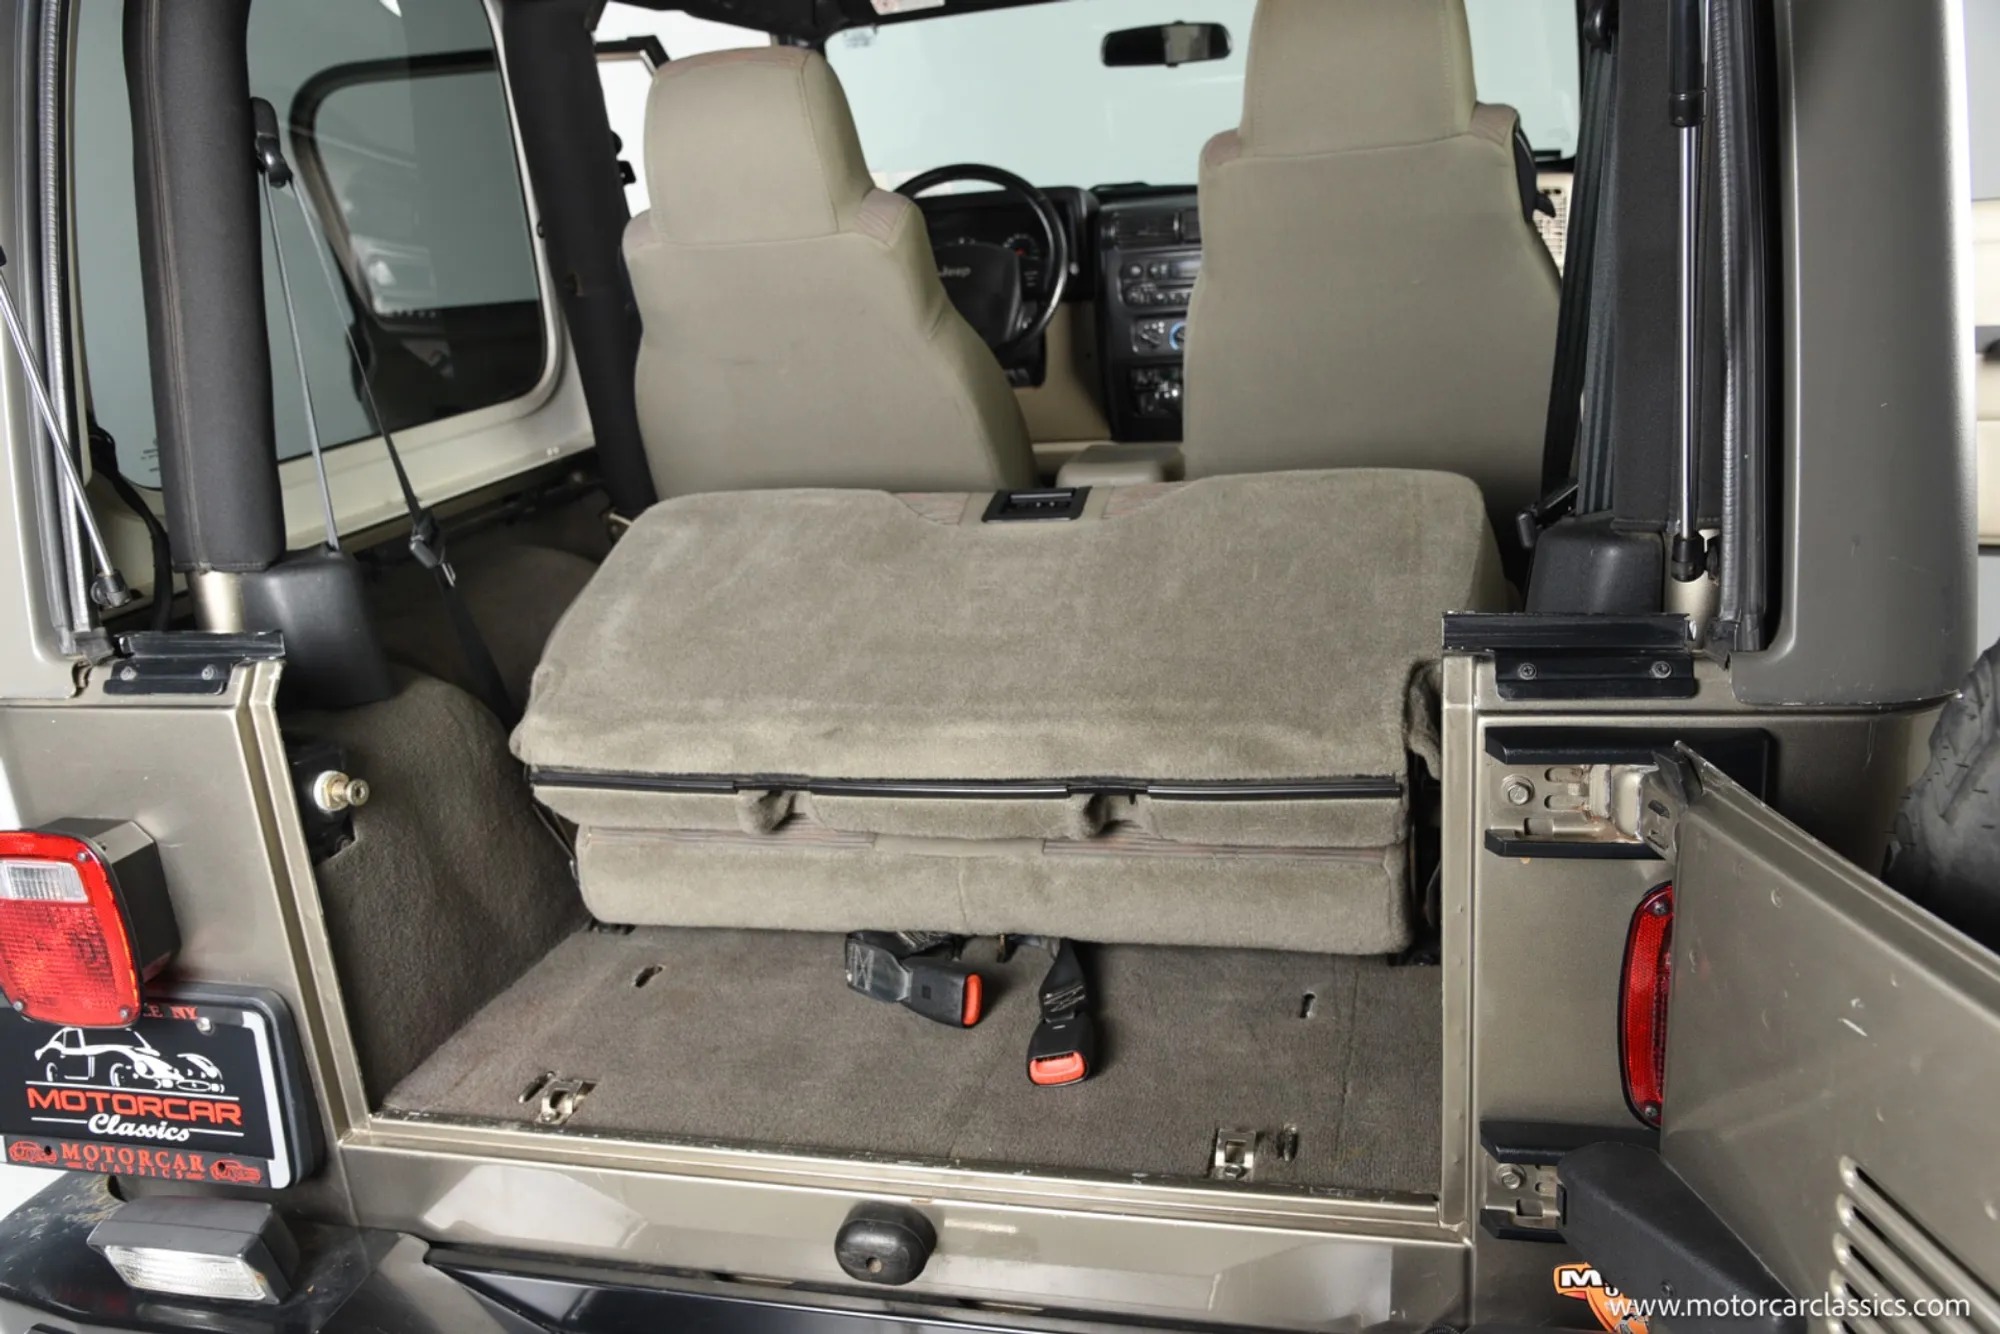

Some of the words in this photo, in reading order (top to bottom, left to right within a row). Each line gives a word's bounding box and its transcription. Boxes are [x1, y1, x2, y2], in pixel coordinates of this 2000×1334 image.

[939, 265, 971, 279] Jeep
[169, 1005, 199, 1020] NY
[26, 1086, 244, 1126] MOTORCAR
[87, 1112, 191, 1142] Classics
[60, 1142, 205, 1173] MOTORCAR
[86, 1161, 184, 1180] CLASSICS
